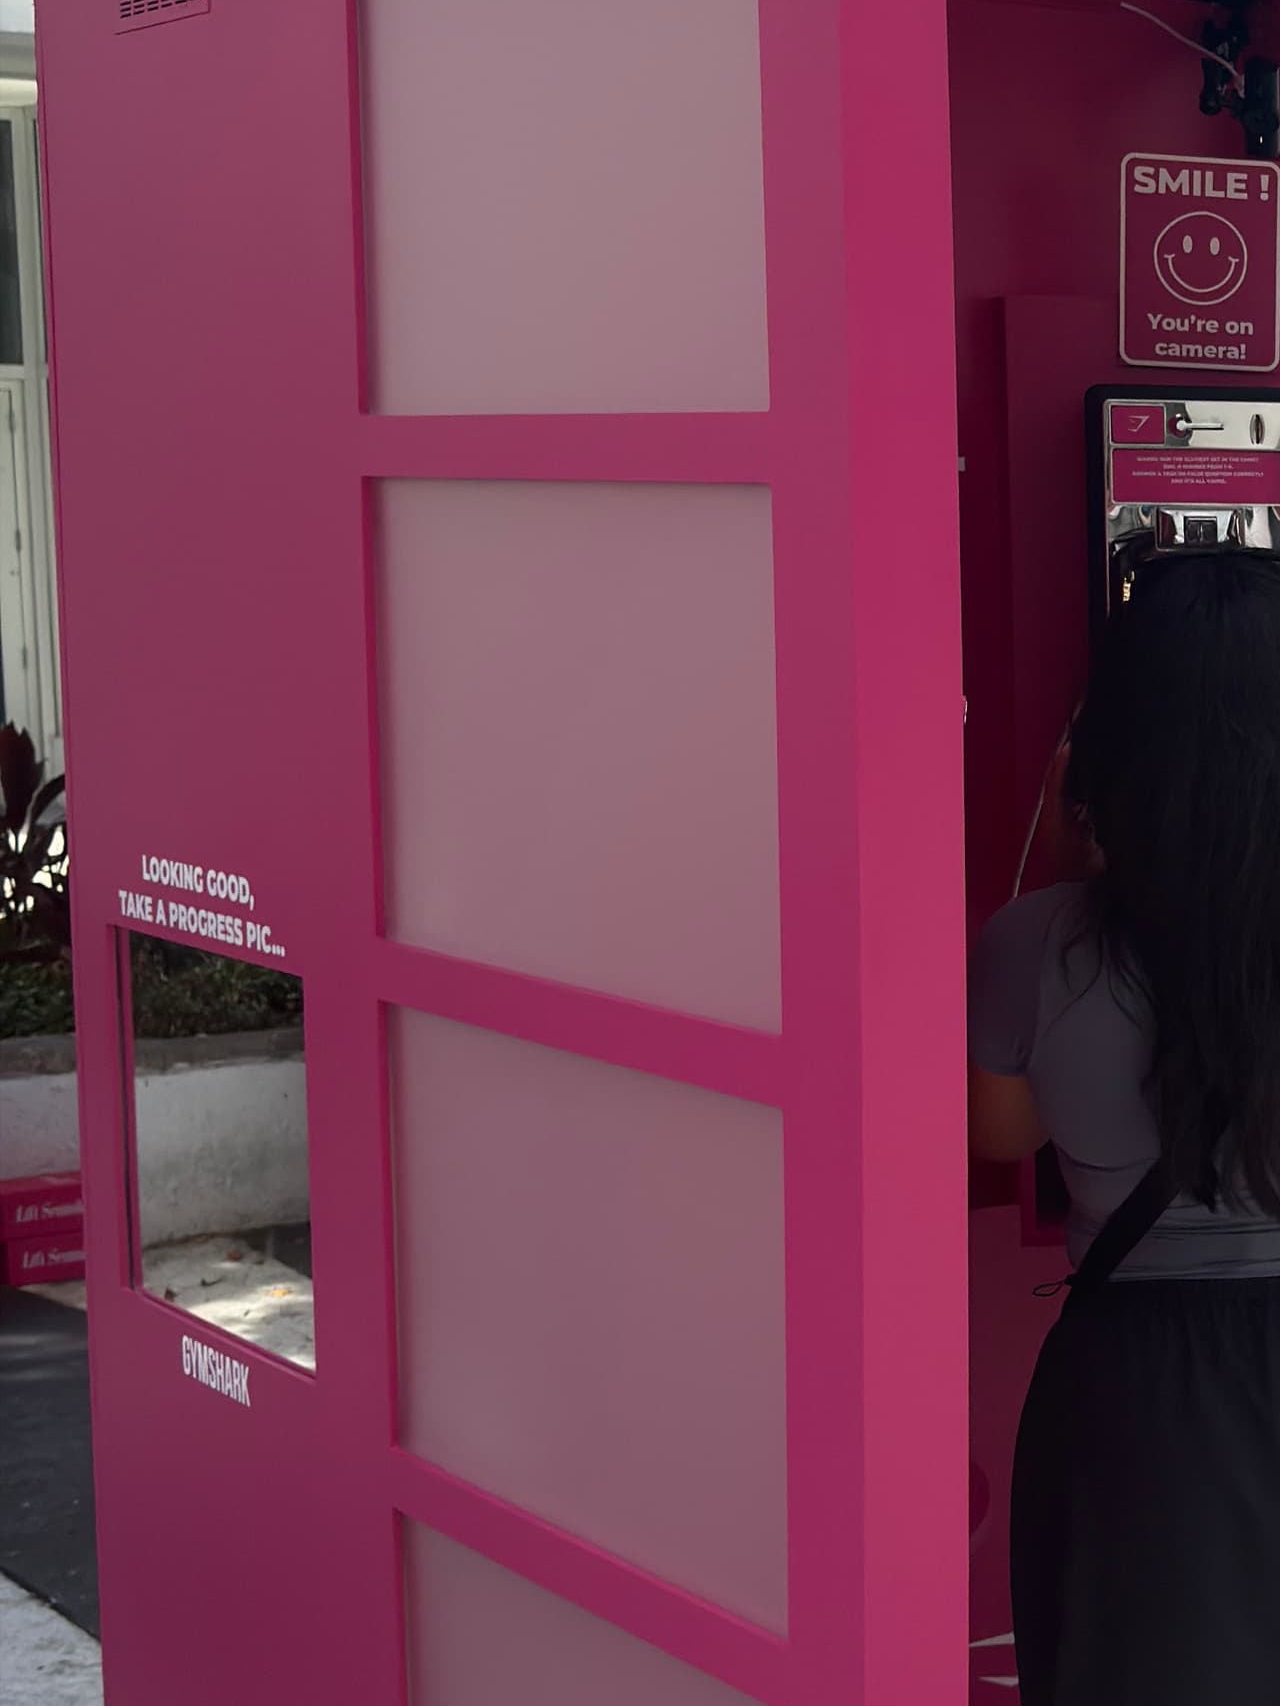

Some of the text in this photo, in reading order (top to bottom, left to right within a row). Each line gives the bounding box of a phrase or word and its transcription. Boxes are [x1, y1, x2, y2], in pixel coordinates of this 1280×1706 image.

[1133, 165, 1248, 200] SMILE
[1147, 312, 1253, 335] You're on
[1154, 342, 1246, 359] camera!
[142, 854, 255, 911] LOOKING GOOD,
[118, 890, 286, 957] TAKE A PROGRESS PIC...
[182, 1335, 251, 1408] GYMSHARK
